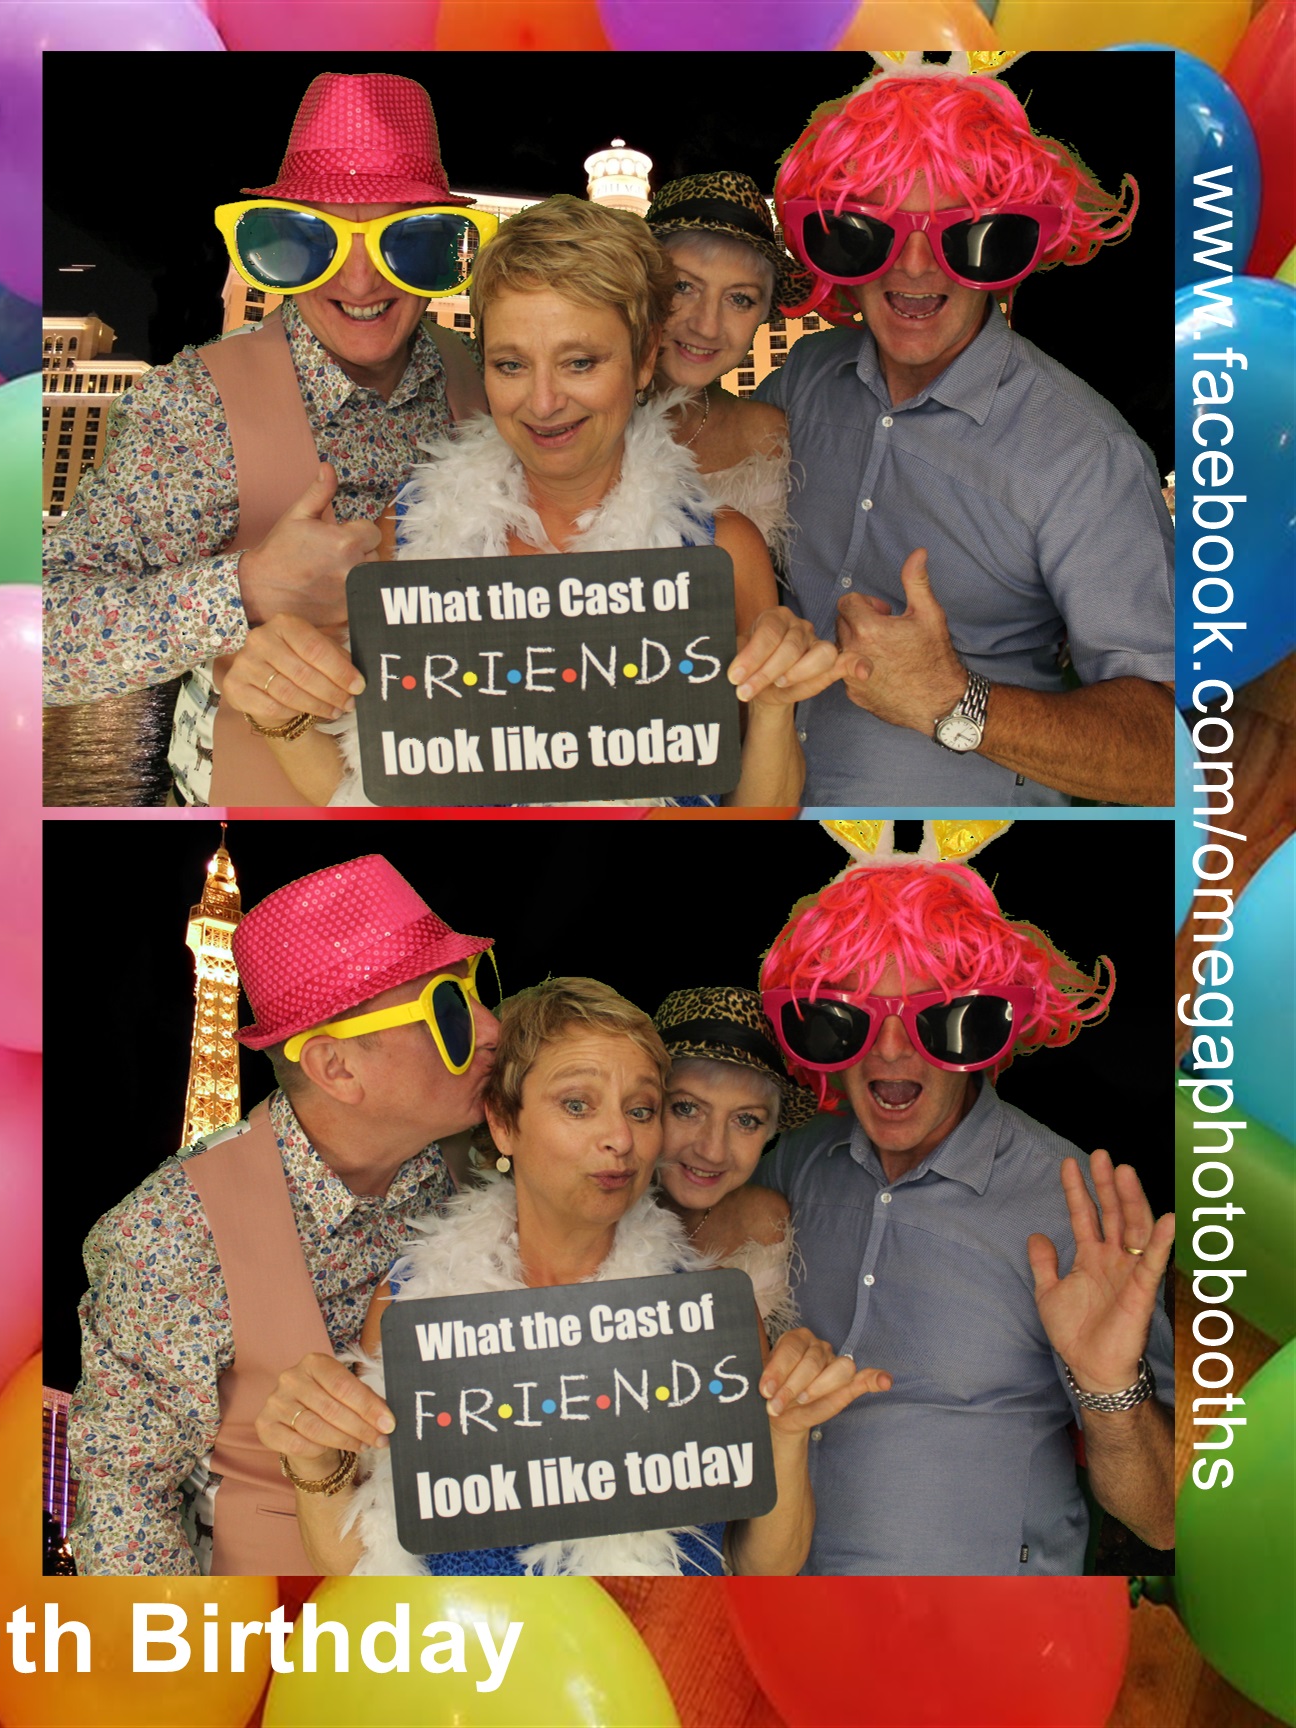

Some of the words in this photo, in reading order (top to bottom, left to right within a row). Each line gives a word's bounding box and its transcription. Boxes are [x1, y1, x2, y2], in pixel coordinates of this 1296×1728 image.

[380, 585, 483, 626] What
[486, 581, 551, 621] the
[558, 576, 646, 618] Cast
[652, 571, 690, 612] of
[381, 728, 484, 776] look
[490, 725, 579, 772] like
[587, 718, 721, 767] today
[414, 1317, 517, 1362] What
[519, 1310, 583, 1351] the
[588, 1300, 674, 1344] Cast
[678, 1292, 715, 1333] of
[416, 1463, 522, 1520] look
[527, 1455, 617, 1508] like
[623, 1440, 754, 1496] today
